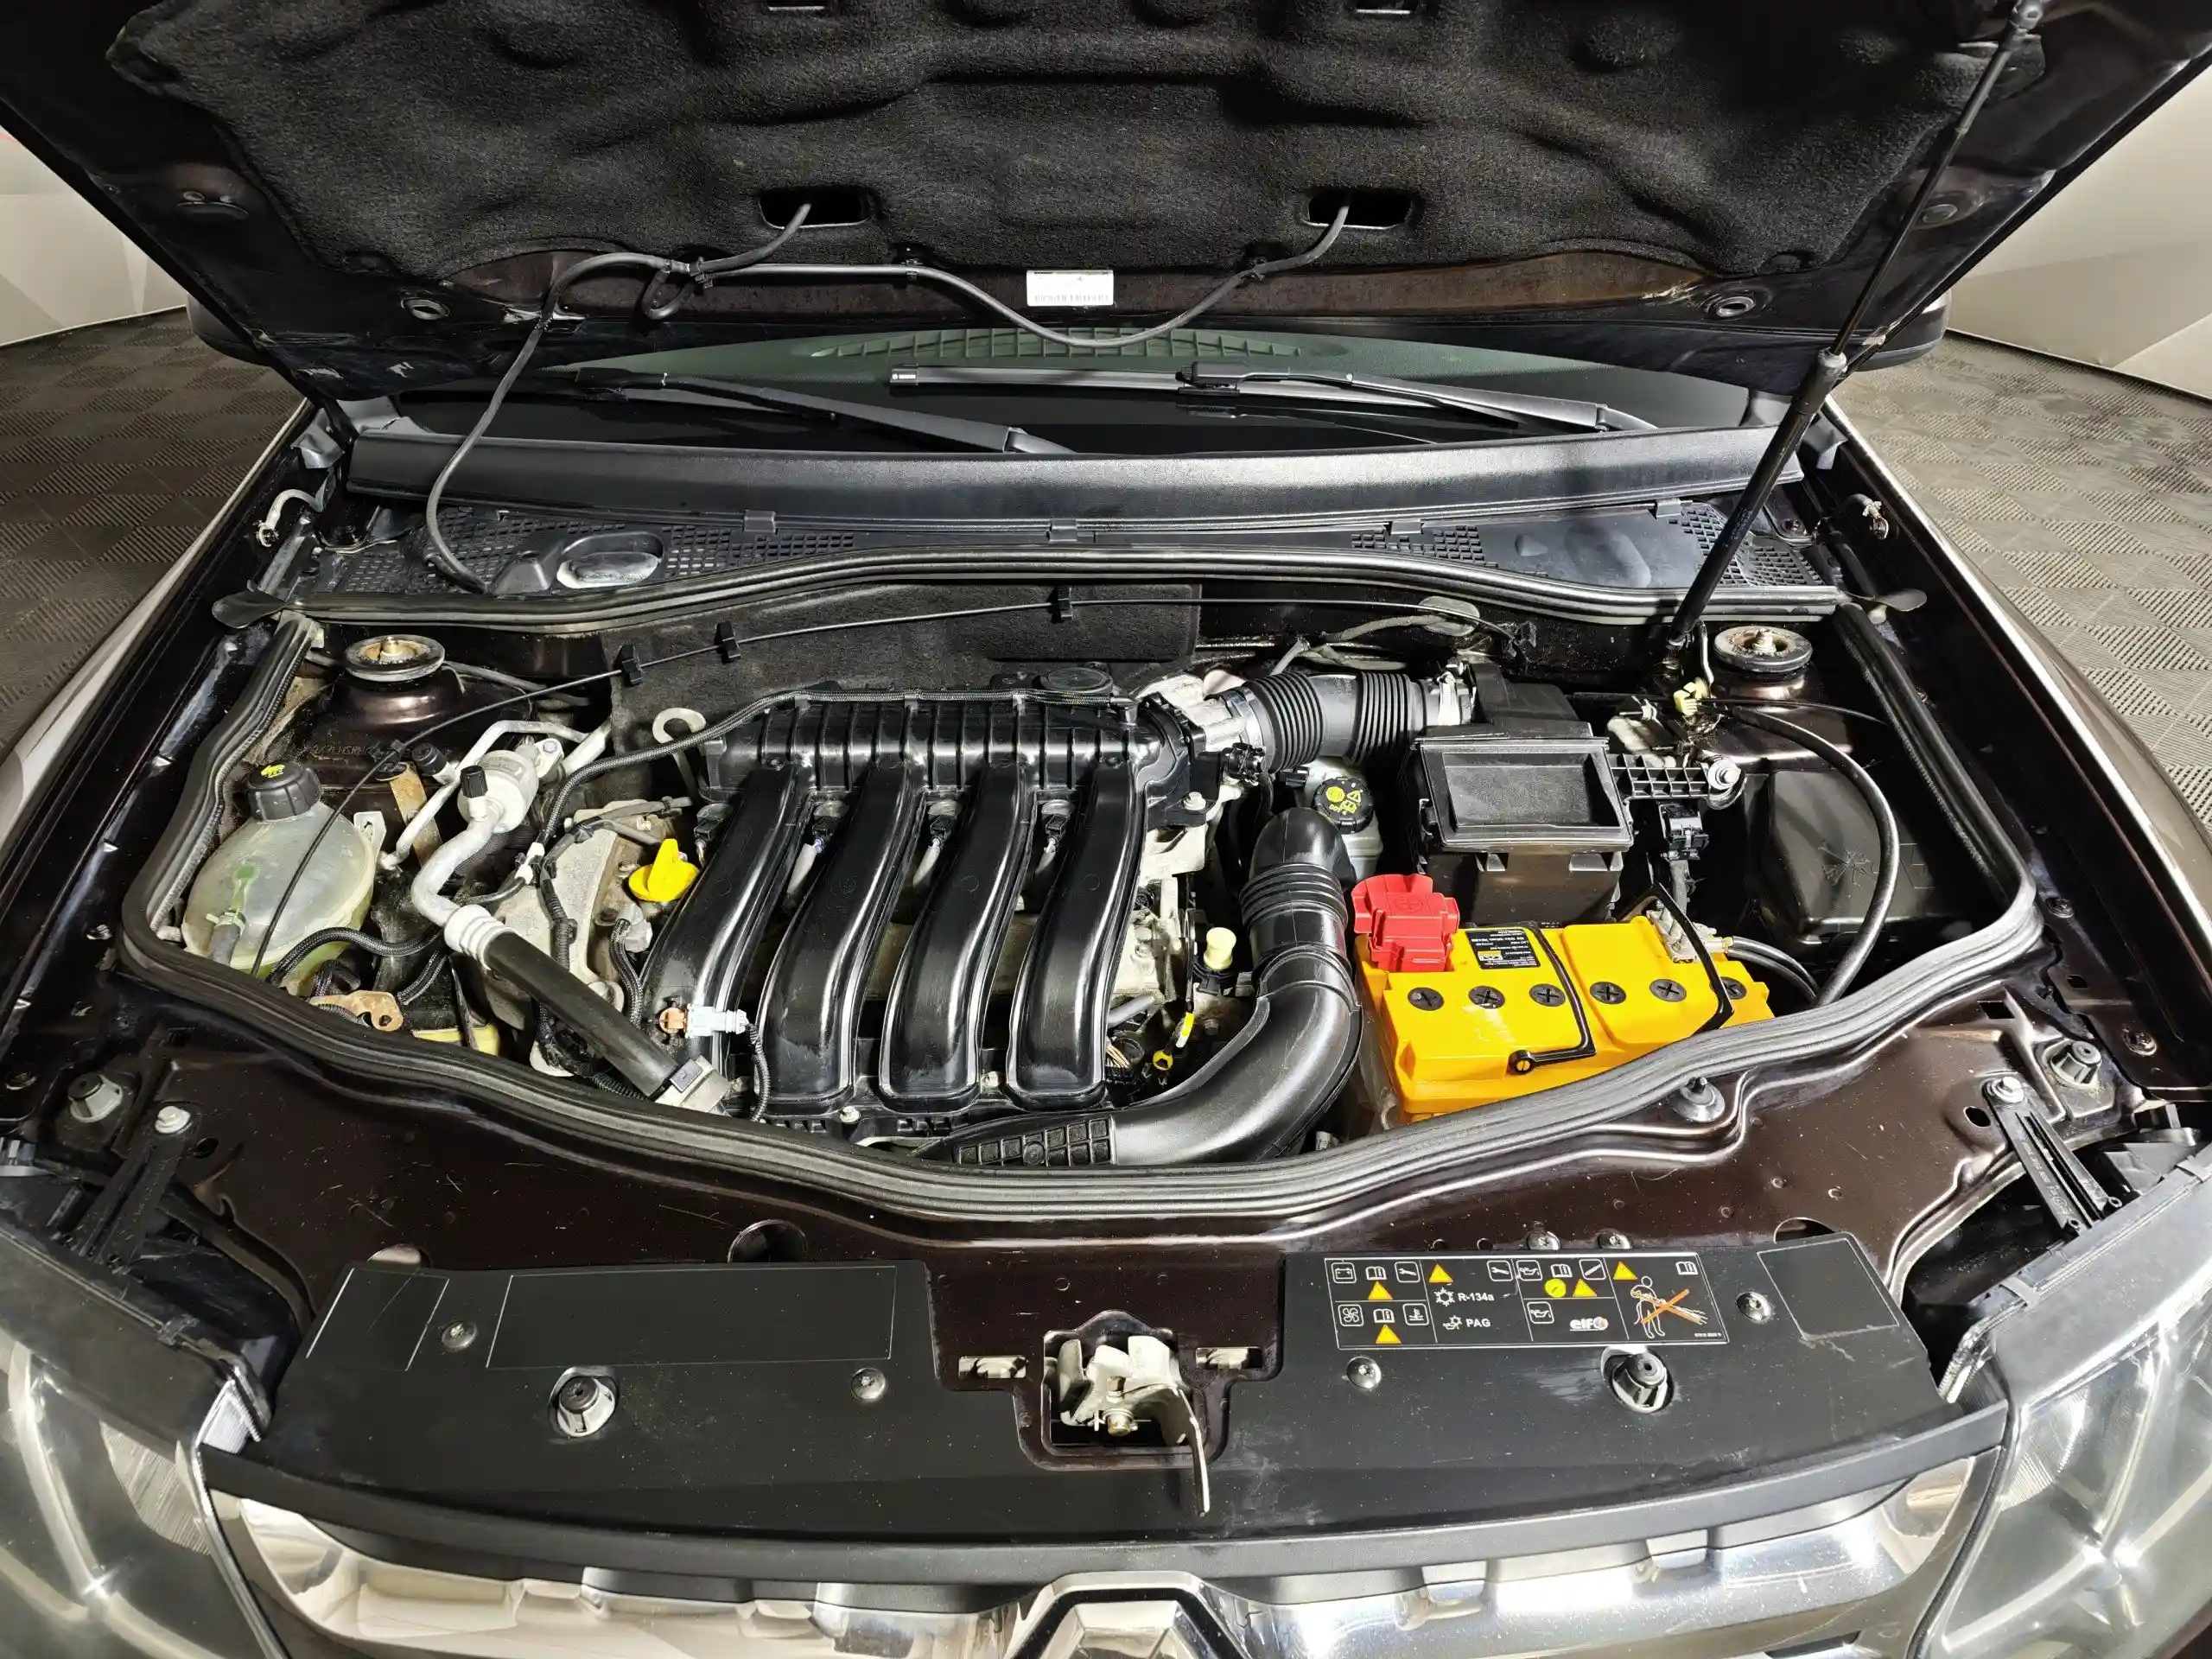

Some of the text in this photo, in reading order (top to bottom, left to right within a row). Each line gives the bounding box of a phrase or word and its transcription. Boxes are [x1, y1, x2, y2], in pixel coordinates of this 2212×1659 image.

[1458, 1293, 1495, 1301] R-134a
[1465, 1318, 1491, 1327] PAG
[1569, 1318, 1592, 1329] elf
